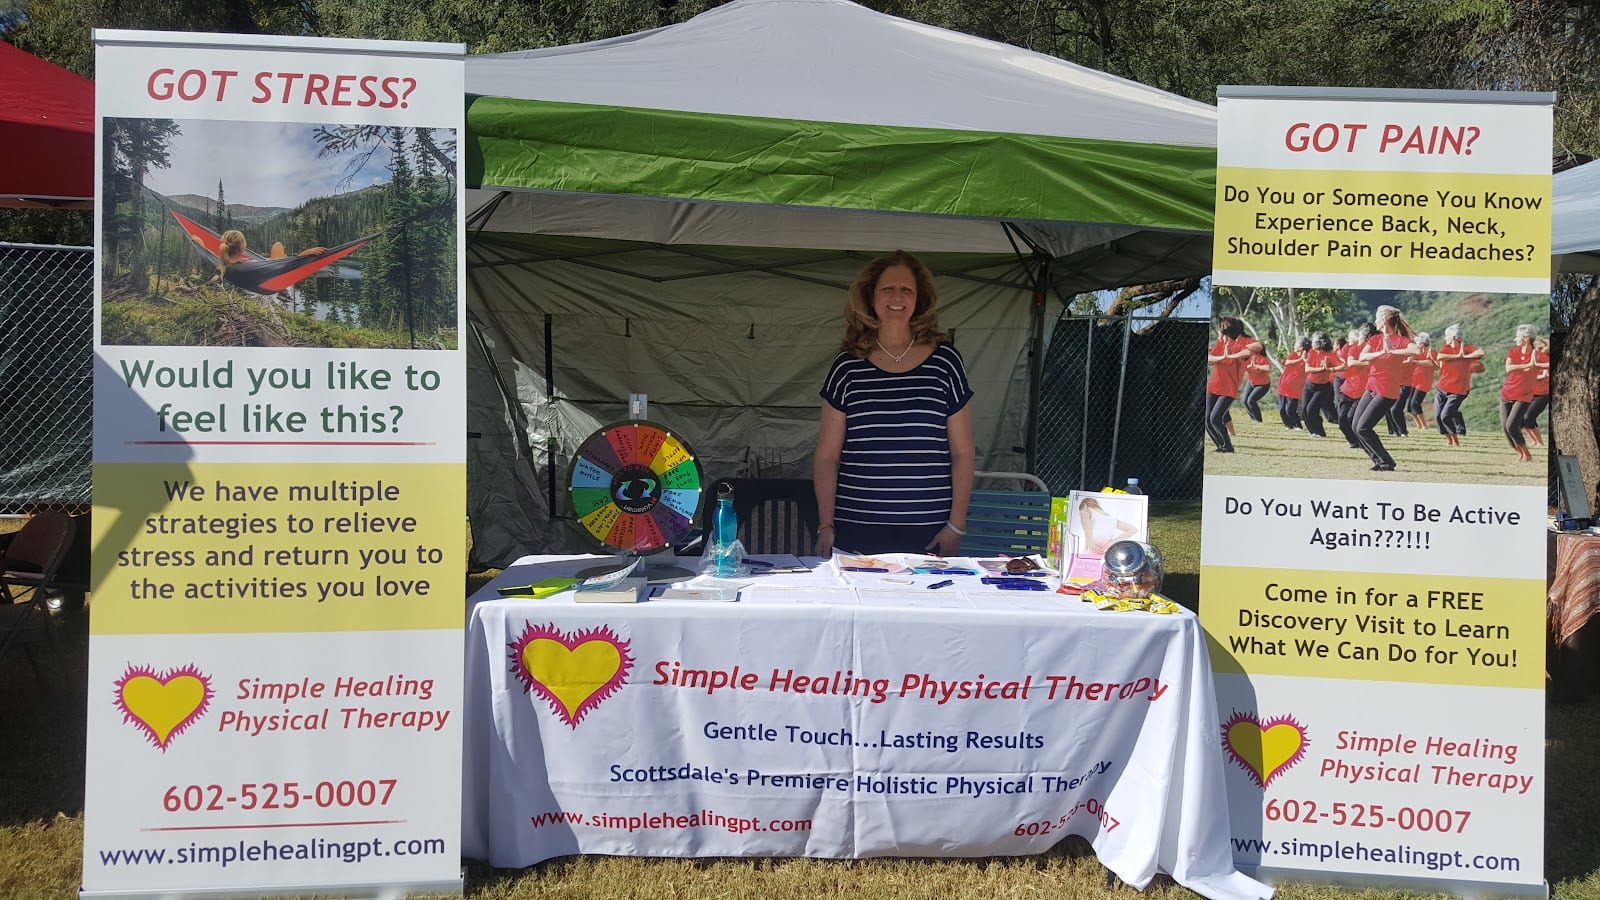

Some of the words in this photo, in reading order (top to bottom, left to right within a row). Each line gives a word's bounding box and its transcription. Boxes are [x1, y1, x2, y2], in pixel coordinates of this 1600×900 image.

[148, 69, 238, 101] GOT
[252, 72, 416, 109] STRESS?
[1286, 123, 1367, 152] GOT
[1379, 125, 1480, 155] PAIN?
[1225, 185, 1249, 202] Do
[1257, 187, 1294, 204] You
[1303, 193, 1325, 204] or
[1333, 189, 1428, 207] Someone
[1437, 191, 1475, 208] You
[1485, 192, 1542, 209] Know
[1256, 213, 1373, 234] Experience
[1383, 215, 1437, 236] Back,
[1448, 217, 1505, 238] Neck,
[1228, 237, 1319, 256] Shoulder
[1328, 240, 1371, 257] Pain
[1381, 245, 1402, 257] or
[1411, 242, 1534, 261] Headaches?
[120, 360, 233, 388] Would
[247, 368, 310, 395] you
[328, 361, 391, 390] like
[405, 365, 440, 390] to
[157, 404, 227, 432] feel
[244, 404, 306, 432] like
[321, 405, 403, 433] this?
[164, 481, 204, 501] We
[216, 481, 278, 501] have
[290, 480, 399, 506] multiple
[145, 514, 277, 538] strategies
[287, 514, 313, 533] to
[325, 512, 416, 533] relieve
[1226, 497, 1252, 515] Do
[1261, 499, 1301, 516] You
[1311, 500, 1368, 519] Want
[1377, 503, 1404, 520] To
[1414, 504, 1440, 522] Be
[1449, 506, 1520, 525] Active
[1310, 528, 1429, 550] Again???!!!
[118, 548, 195, 567] stress
[206, 545, 253, 566] and
[264, 546, 348, 566] return
[359, 549, 405, 570] you
[417, 545, 442, 563] to
[131, 578, 174, 599] the
[185, 577, 307, 598] activities
[317, 582, 364, 602] you
[377, 576, 430, 596] love
[1265, 584, 1327, 603] Come
[1336, 587, 1355, 604] in
[1365, 588, 1398, 606] for
[1407, 595, 1418, 607] a
[1428, 591, 1483, 610] FREE
[1240, 609, 1347, 635] Discovery
[1355, 615, 1404, 634] Visit
[1413, 619, 1436, 636] to
[1446, 619, 1509, 639] Learn
[1229, 635, 1286, 656] What
[1295, 639, 1329, 657] We
[1338, 642, 1378, 660] Can
[1389, 644, 1416, 662] Do
[1425, 646, 1458, 664] for
[1467, 648, 1516, 667] You!
[237, 677, 324, 704] Simple
[334, 674, 433, 700] Healing
[653, 661, 758, 694] Simple
[769, 669, 889, 704] Healing
[900, 674, 1031, 705] Physical
[1046, 676, 1168, 701] Therapy
[219, 709, 328, 736] Physical
[341, 708, 450, 732] Therapy
[704, 722, 777, 741] Gentle
[785, 726, 958, 752] Touch...Lasting
[967, 732, 1043, 748] Results
[1336, 731, 1417, 754] Simple
[1426, 737, 1517, 764] Healing
[611, 763, 738, 784] Scottsdale's
[748, 770, 849, 791] Premiere
[857, 776, 937, 794] Holistic
[946, 777, 1032, 798] Physical
[1042, 761, 1111, 793] Therapy
[1320, 759, 1420, 783] Physical
[1432, 766, 1533, 794] Therapy
[164, 779, 397, 811] 602-525-0007
[531, 810, 812, 833] www.simplehealingpt.com
[1265, 799, 1471, 834] 602-525-0007
[100, 838, 444, 867] www.simplehealingpt.com
[1231, 838, 1520, 871] ww.simplehealingpt.com
